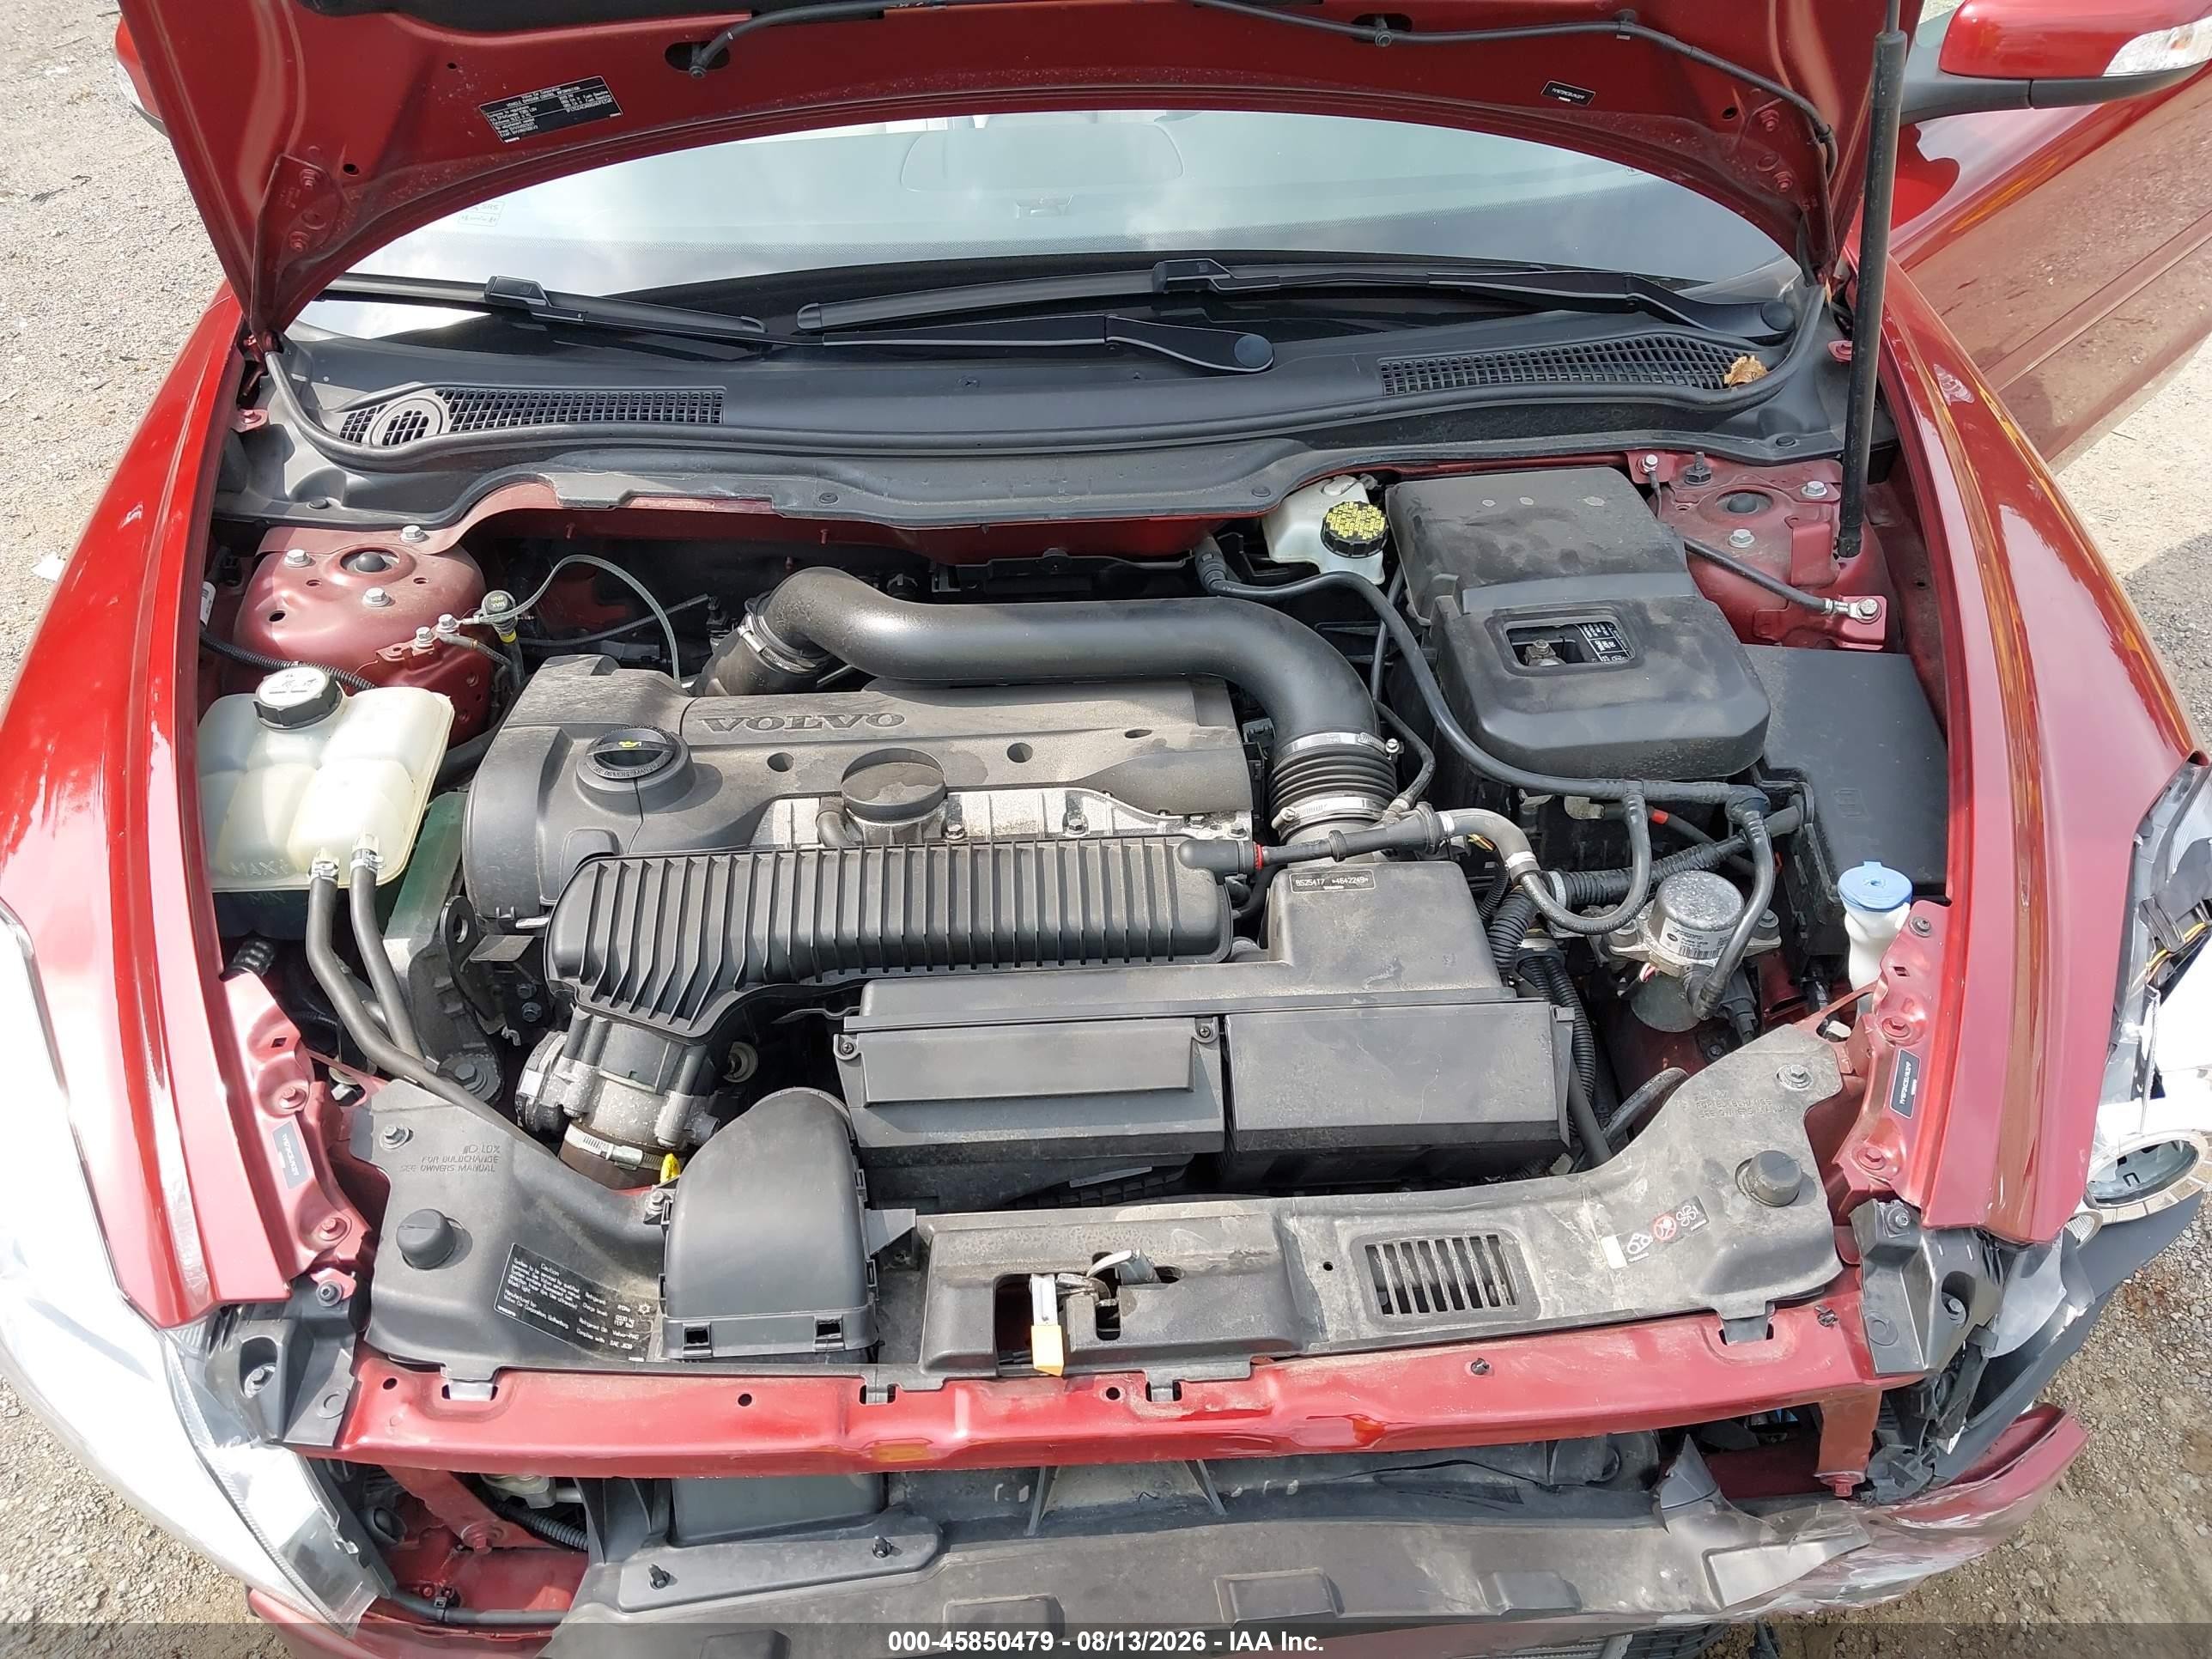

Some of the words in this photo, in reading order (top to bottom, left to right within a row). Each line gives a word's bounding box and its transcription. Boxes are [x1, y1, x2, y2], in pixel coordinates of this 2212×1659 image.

[698, 712, 905, 732] VOLVO
[458, 1164, 495, 1173] MANUAL
[541, 1263, 559, 1276] Caution
[504, 1295, 515, 1303] Volvo
